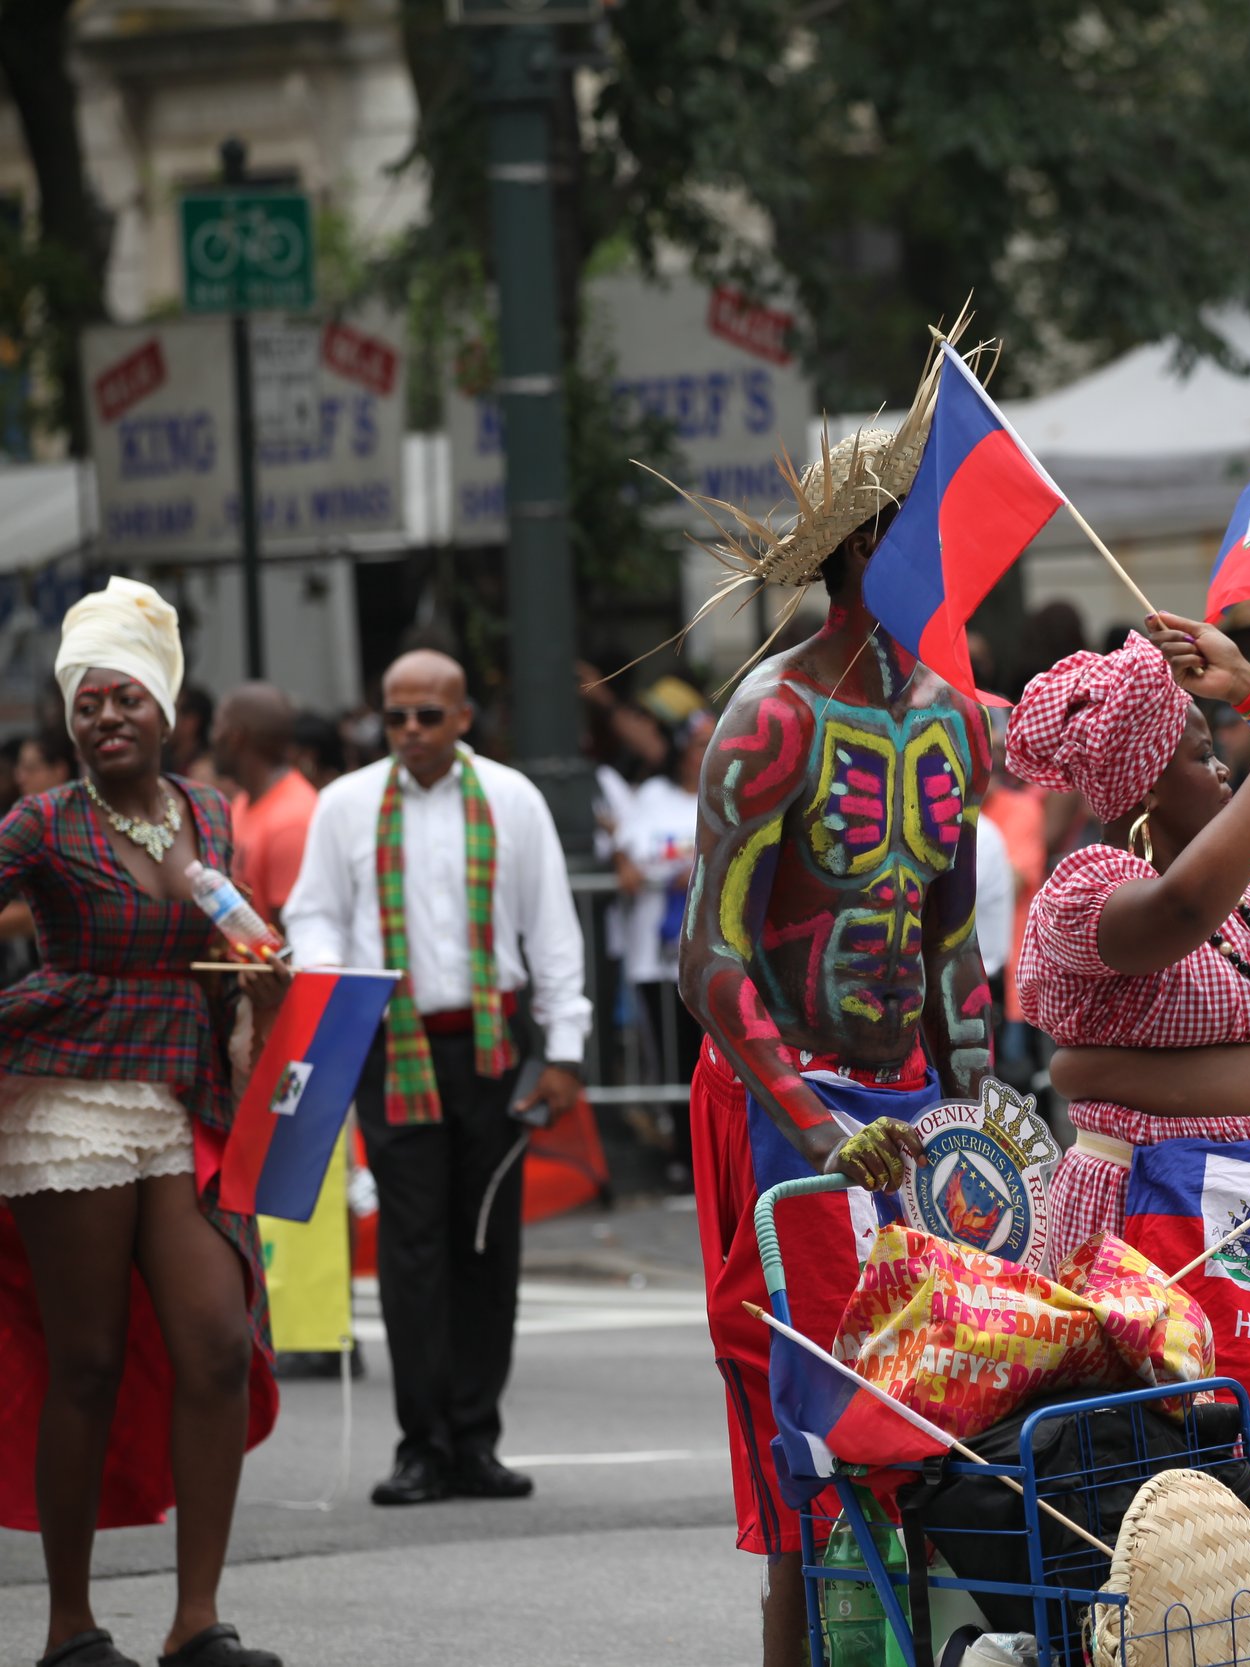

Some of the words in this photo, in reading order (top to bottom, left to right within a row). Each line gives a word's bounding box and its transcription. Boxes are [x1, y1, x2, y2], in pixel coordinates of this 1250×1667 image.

[118, 410, 218, 480] KING
[914, 1106, 978, 1142] HOENIX
[905, 1166, 920, 1221] HAITIAN
[920, 1176, 930, 1209] FROM
[927, 1146, 943, 1167] EX
[942, 1135, 1006, 1172] CINERIBUS
[1004, 1171, 1026, 1251] NASCITUR
